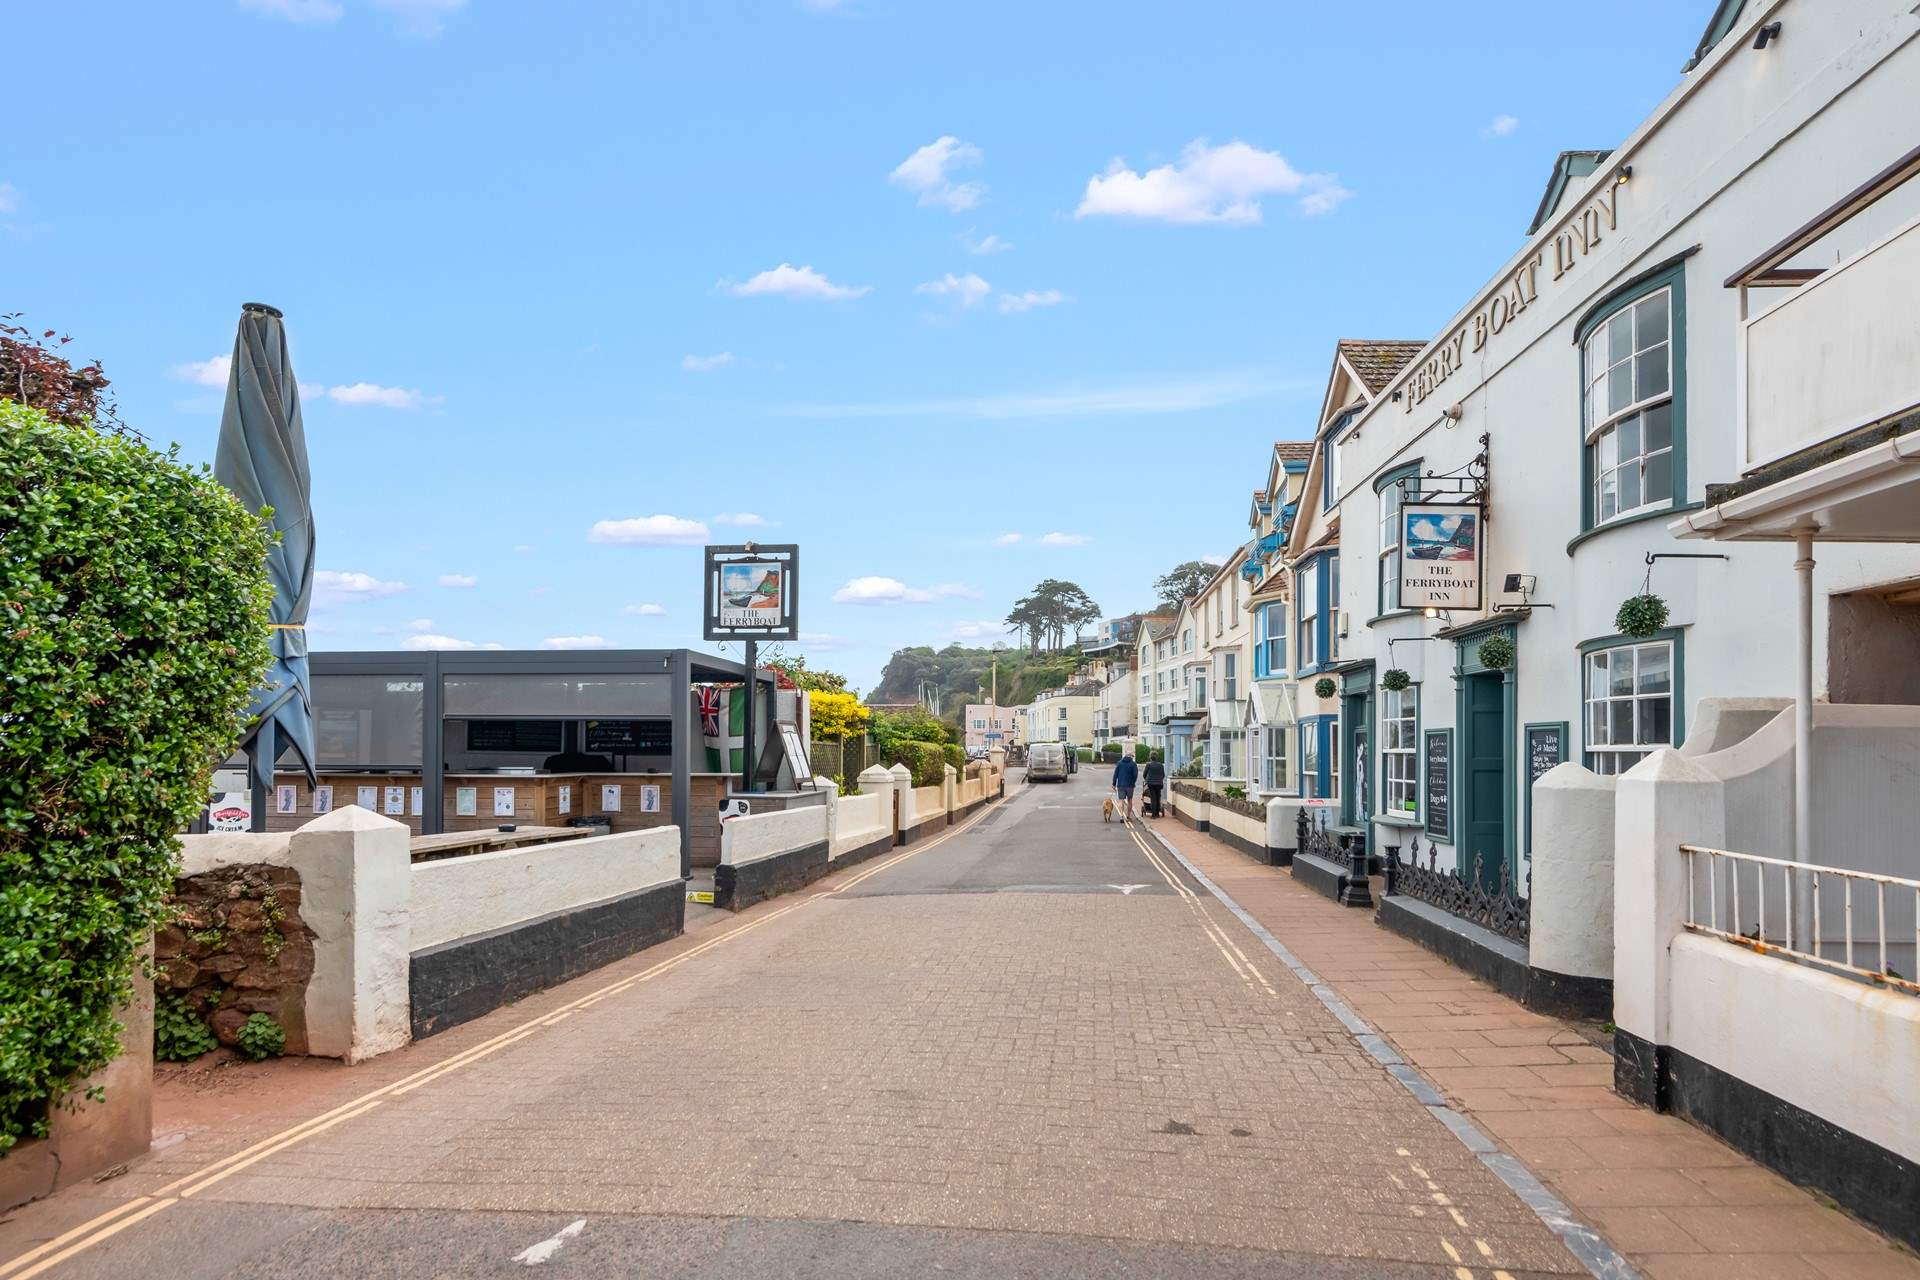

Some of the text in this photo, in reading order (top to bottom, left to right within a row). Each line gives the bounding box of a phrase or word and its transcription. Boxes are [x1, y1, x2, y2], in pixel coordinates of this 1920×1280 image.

[1405, 182, 1619, 413] FERRY BOAT INN
[1428, 566, 1453, 575] THE
[1405, 578, 1476, 589] FERRYBOAT
[1429, 592, 1450, 601] INN
[743, 609, 760, 617] THE
[723, 617, 777, 626] FERRYBOAT
